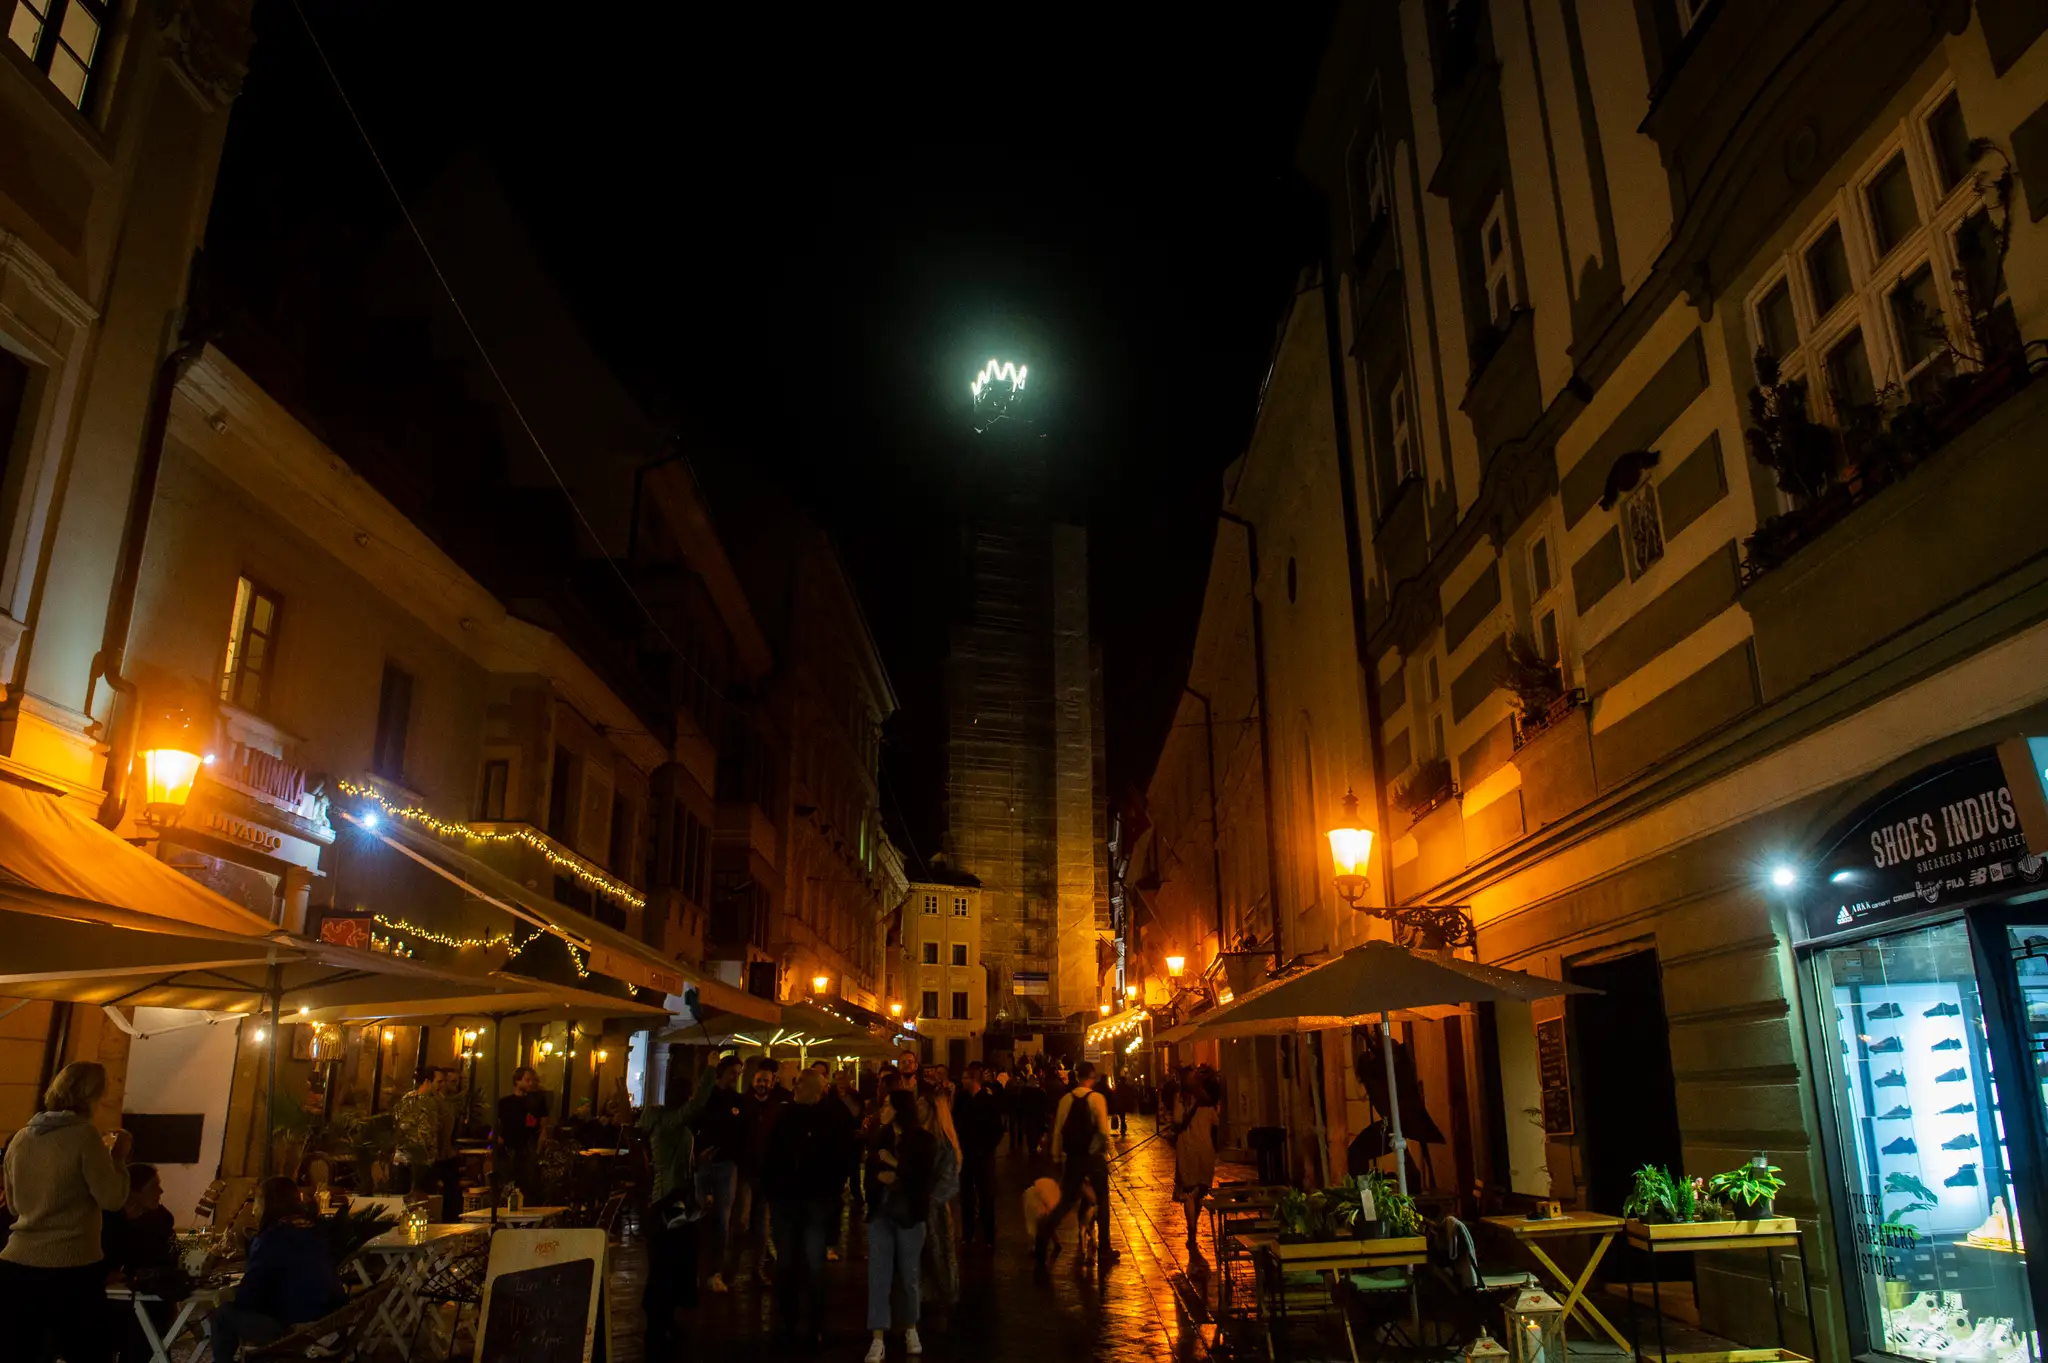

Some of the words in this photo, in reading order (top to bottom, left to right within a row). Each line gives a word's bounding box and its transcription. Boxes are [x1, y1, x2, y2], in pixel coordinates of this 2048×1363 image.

[206, 813, 282, 850] DIVADLO
[1871, 813, 1937, 868] SHOES
[1941, 787, 2016, 847] INDUS
[1917, 852, 1962, 873] SNEAKERS
[1968, 846, 1985, 859] AND
[1990, 833, 2027, 852] STREET
[1946, 879, 1964, 890] FILA
[1852, 1193, 1882, 1216] YOUR
[1857, 1223, 1916, 1250] SNEAKERS
[1861, 1252, 1897, 1278] STORE
